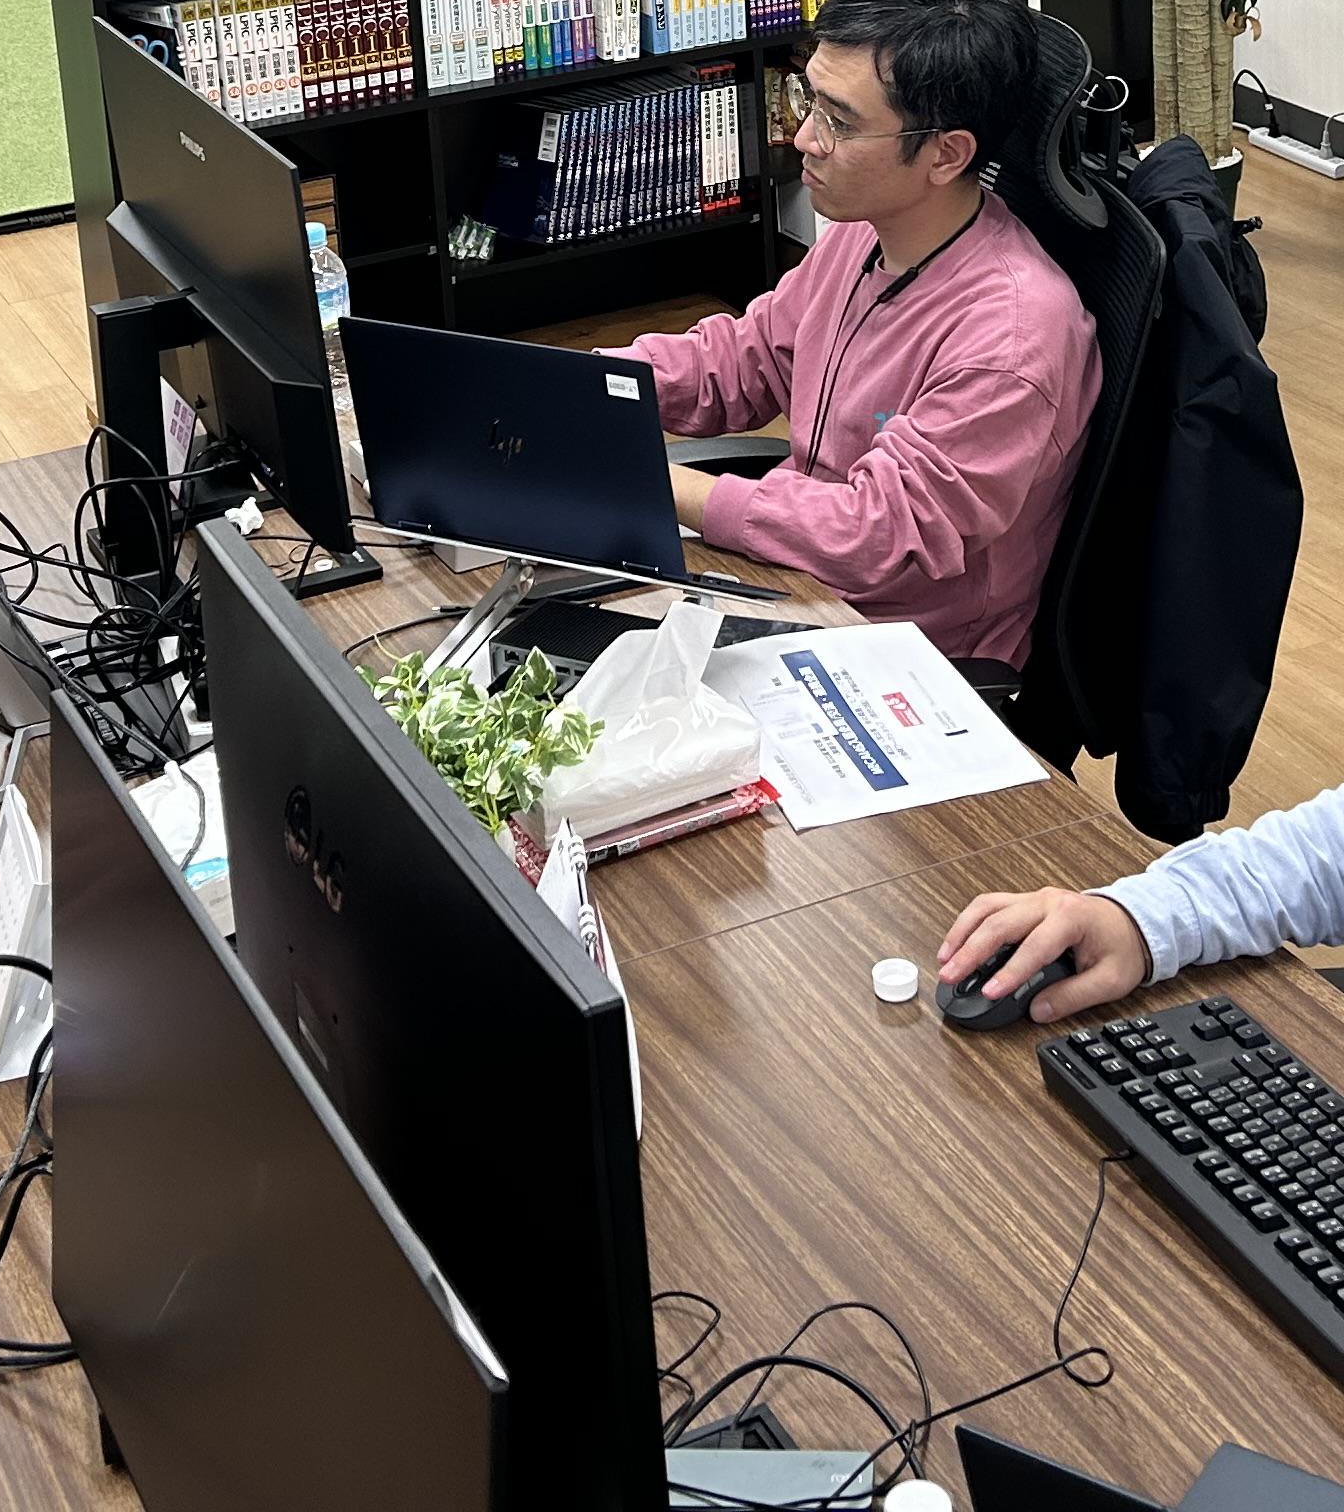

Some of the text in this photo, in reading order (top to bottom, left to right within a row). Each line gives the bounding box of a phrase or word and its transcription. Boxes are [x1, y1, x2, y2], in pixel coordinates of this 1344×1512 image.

[186, 24, 197, 58] LPIC 1
[203, 21, 212, 56] LPIC 1
[223, 17, 232, 52] LPIC 1
[240, 15, 249, 49] LPIC 1
[255, 13, 264, 47] LPIC 1
[270, 10, 279, 45] LPIC 1
[284, 8, 294, 42] LPIC 1
[297, 4, 314, 64] LPIC 1
[313, 1, 329, 60] LPIC 1
[329, 0, 346, 57] LPIC 1
[383, 31, 392, 49] 1
[399, 28, 408, 46] 1
[351, 37, 360, 55] 1
[367, 34, 376, 52] 1
